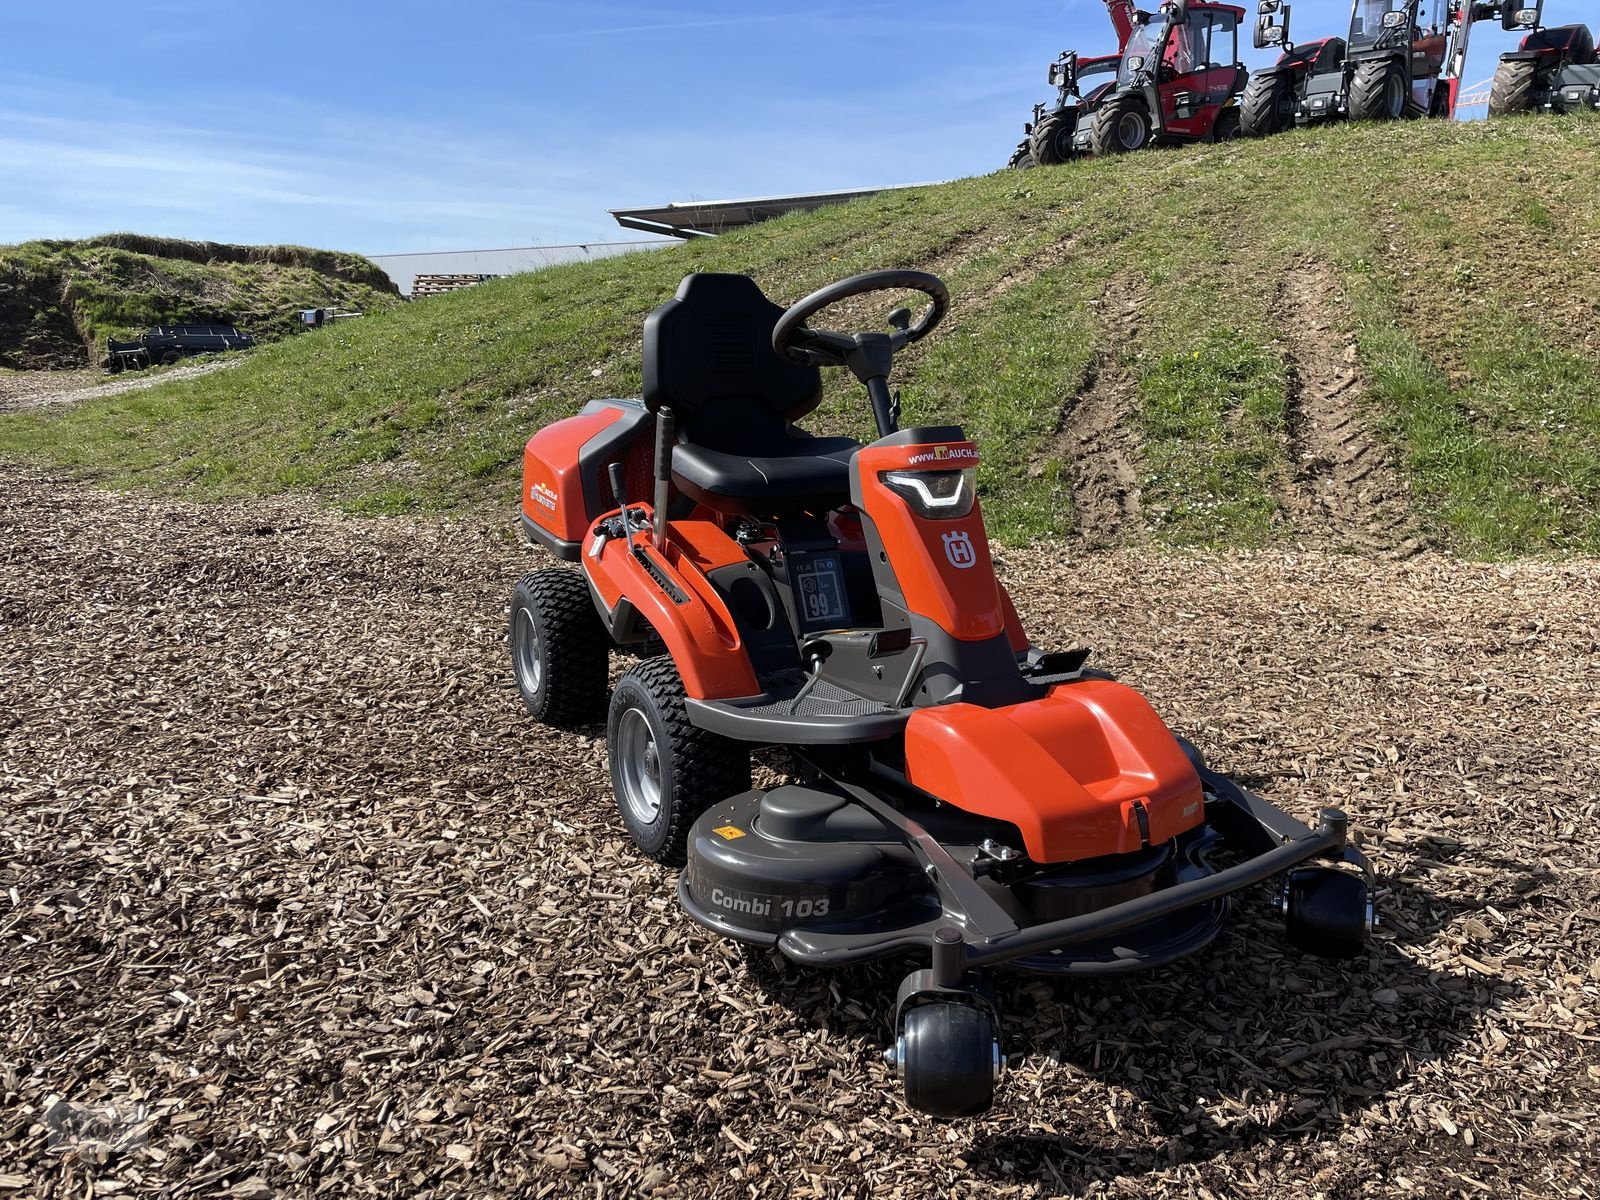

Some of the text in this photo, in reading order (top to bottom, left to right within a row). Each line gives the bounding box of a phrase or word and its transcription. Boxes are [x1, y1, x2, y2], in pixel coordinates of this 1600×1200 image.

[809, 593, 829, 616] 99
[711, 888, 830, 917] Combi 103
